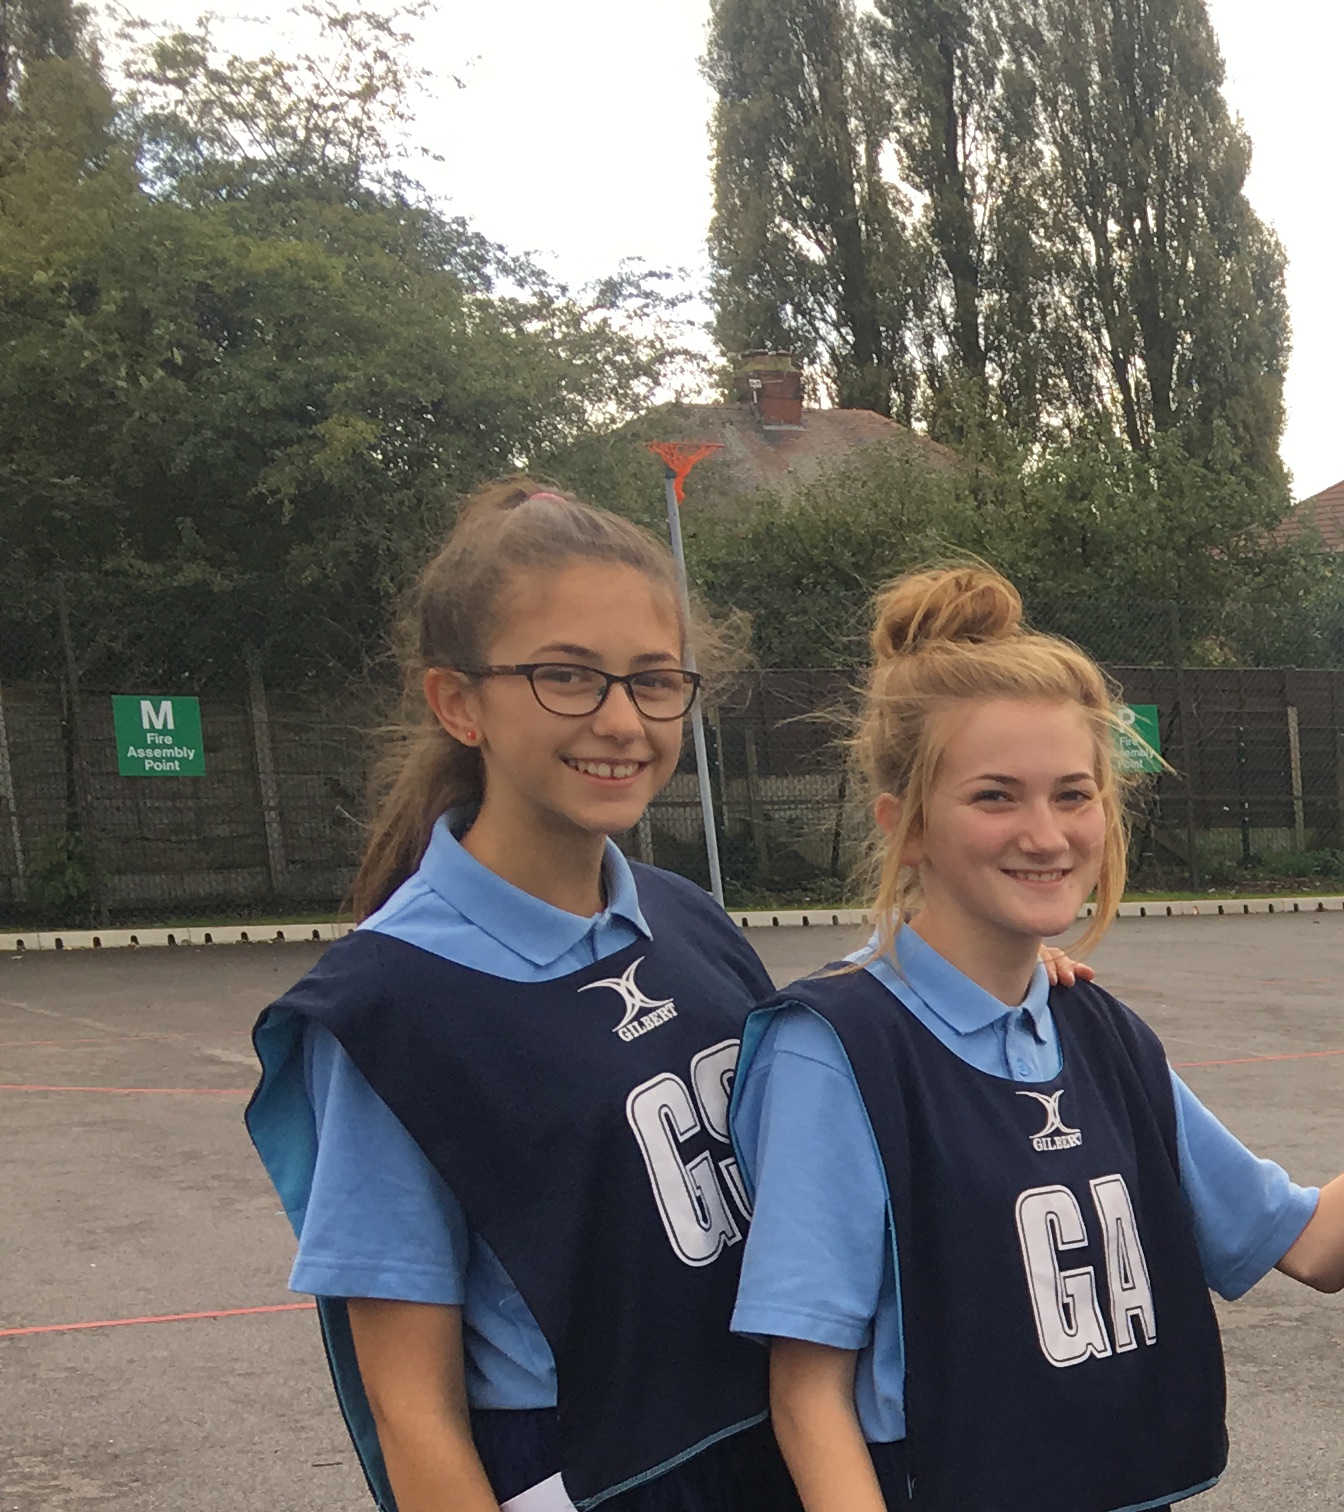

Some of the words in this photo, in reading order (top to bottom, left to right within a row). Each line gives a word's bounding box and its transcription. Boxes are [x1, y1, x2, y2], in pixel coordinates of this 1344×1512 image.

[140, 700, 175, 729] M
[146, 732, 173, 744] Fire
[127, 746, 196, 760] Assembly
[144, 759, 180, 771] Point
[617, 1001, 679, 1042] GILBERT
[1015, 1174, 1157, 1368] GA
